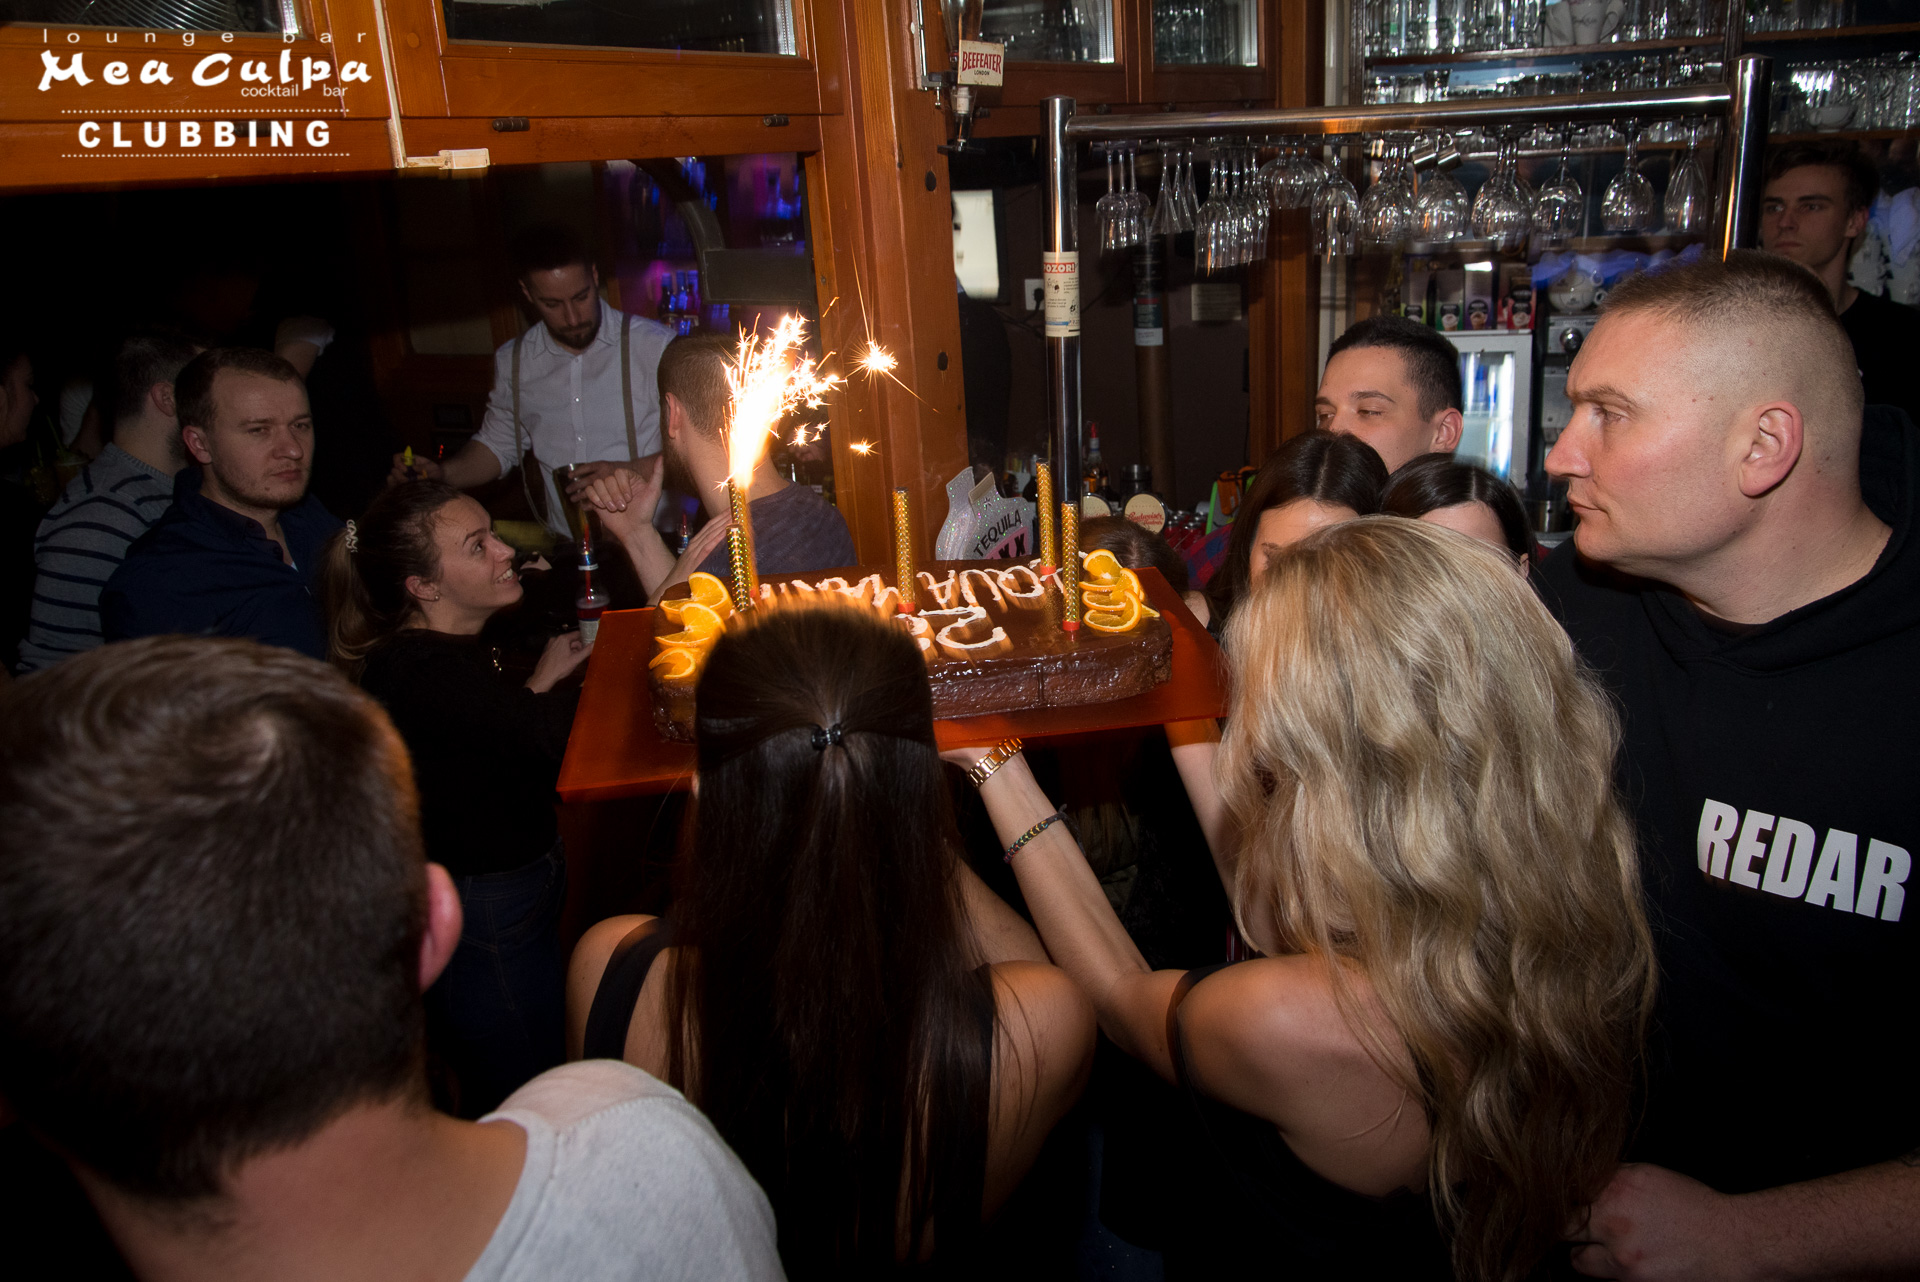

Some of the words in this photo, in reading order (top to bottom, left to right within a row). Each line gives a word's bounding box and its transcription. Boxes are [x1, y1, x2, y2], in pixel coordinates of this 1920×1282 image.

[962, 51, 1002, 75] BEEFEATER
[973, 509, 1022, 557] TEQUILA
[990, 533, 1026, 559] XX
[1697, 798, 1912, 922] REDAR
